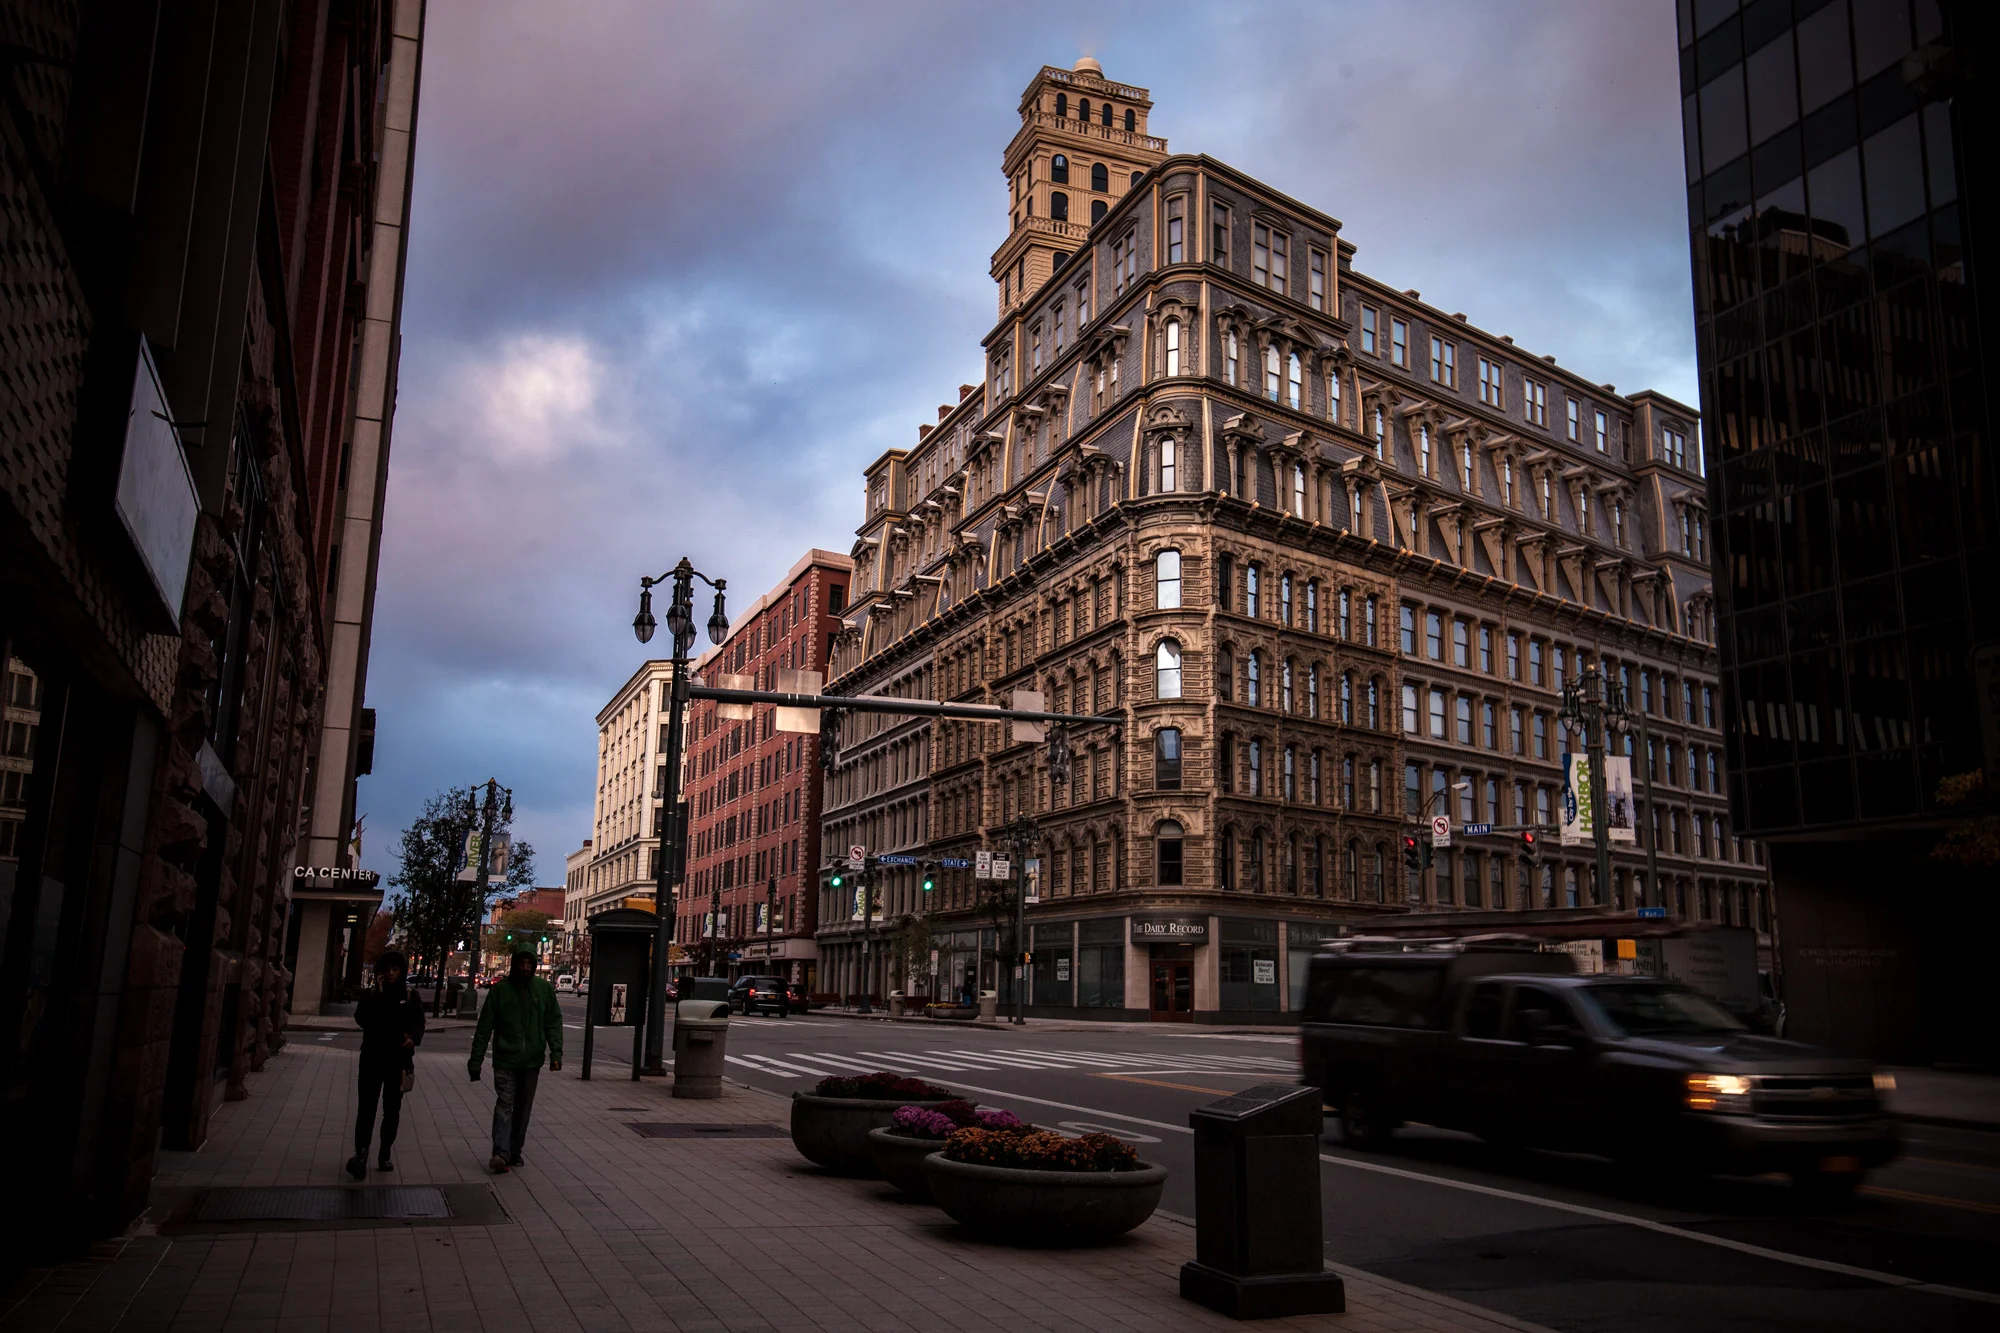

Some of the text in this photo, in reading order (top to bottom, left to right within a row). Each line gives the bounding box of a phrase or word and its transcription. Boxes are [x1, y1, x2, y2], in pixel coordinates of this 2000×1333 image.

[1577, 760, 1594, 832] HARBOR
[1467, 824, 1488, 834] MAIN
[467, 835, 481, 867] RIVER
[886, 856, 917, 864] EXCHANGE
[943, 859, 961, 867] STATE
[320, 867, 371, 880] CENTER
[1144, 923, 1166, 933] DAILY
[1170, 923, 1204, 934] RECORD
[1816, 958, 1881, 966] BUILDING
